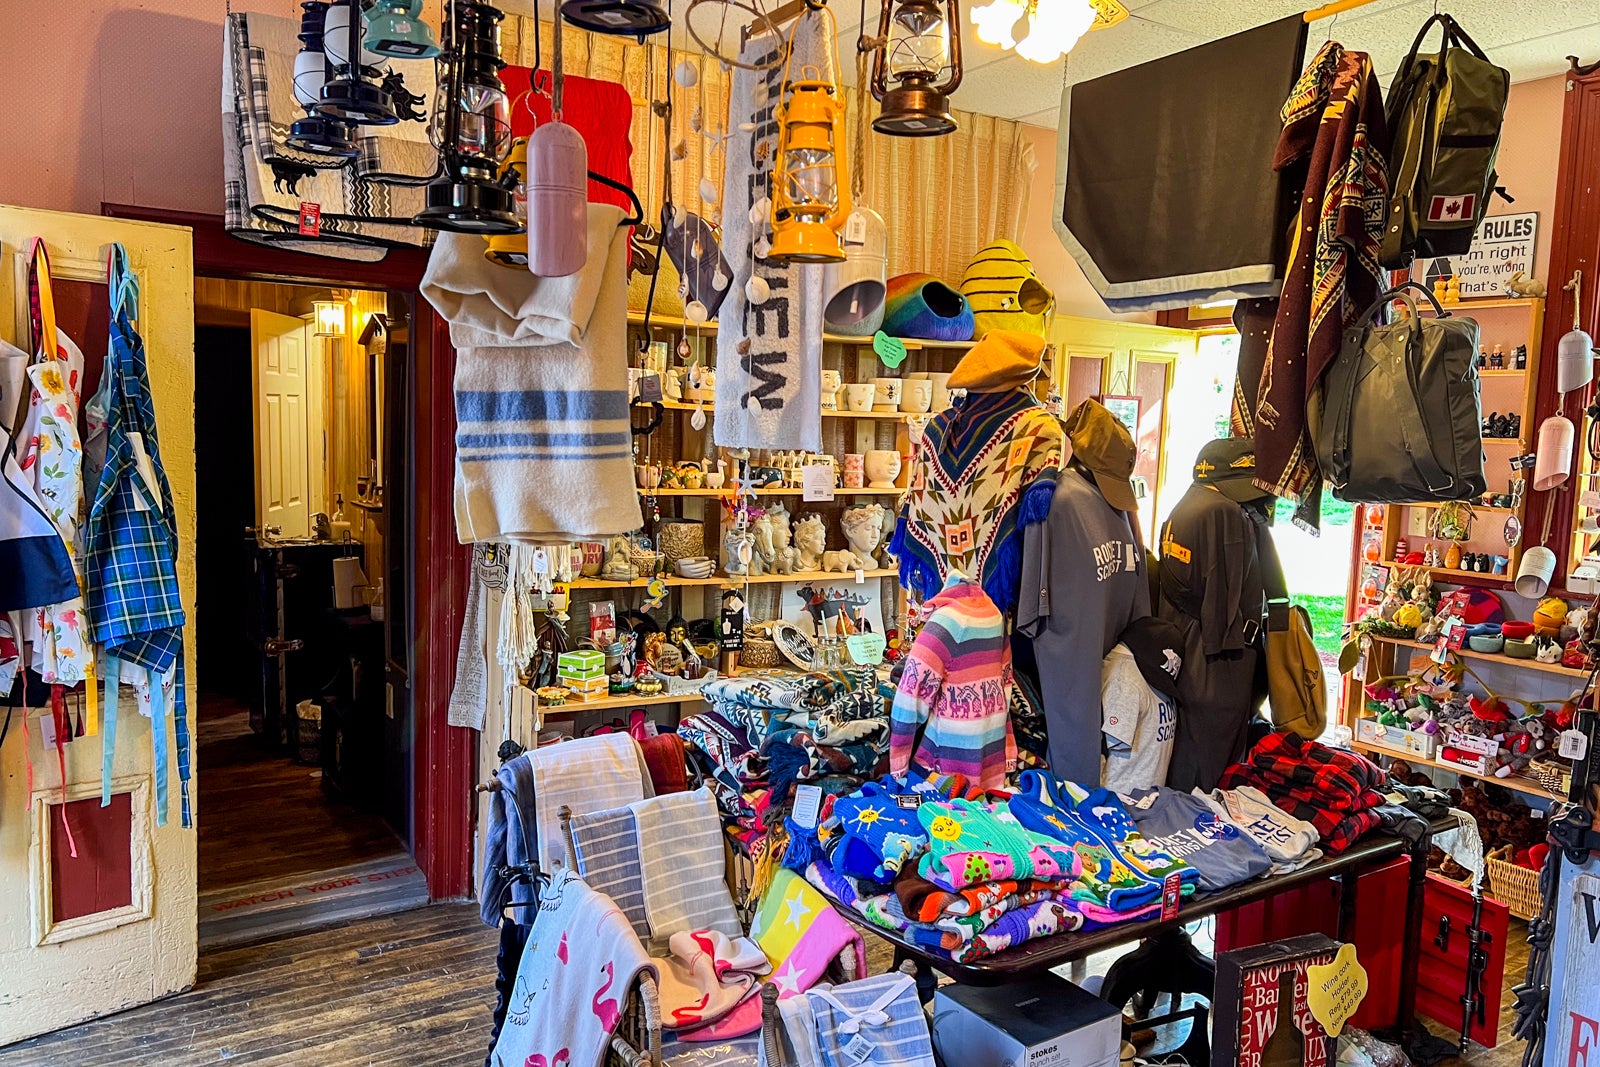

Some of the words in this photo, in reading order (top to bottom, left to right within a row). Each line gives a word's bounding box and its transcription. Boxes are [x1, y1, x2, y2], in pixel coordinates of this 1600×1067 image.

[1483, 218, 1533, 240] RULES
[1489, 244, 1527, 261] right
[1458, 265, 1489, 279] you're
[1459, 281, 1498, 293] That's
[211, 891, 295, 912] WATCH
[305, 877, 361, 893] YOUR
[366, 866, 418, 883] STEP
[1321, 974, 1339, 993] Wine
[1338, 961, 1351, 977] cork
[1331, 976, 1350, 1000] Holder
[1340, 979, 1359, 1005] $79.99
[1331, 1013, 1345, 1029] Now
[1343, 989, 1363, 1014] $49.99
[1029, 1055, 1051, 1067] Punch
[1050, 1053, 1062, 1062] set
[1030, 1045, 1058, 1060] stokes
